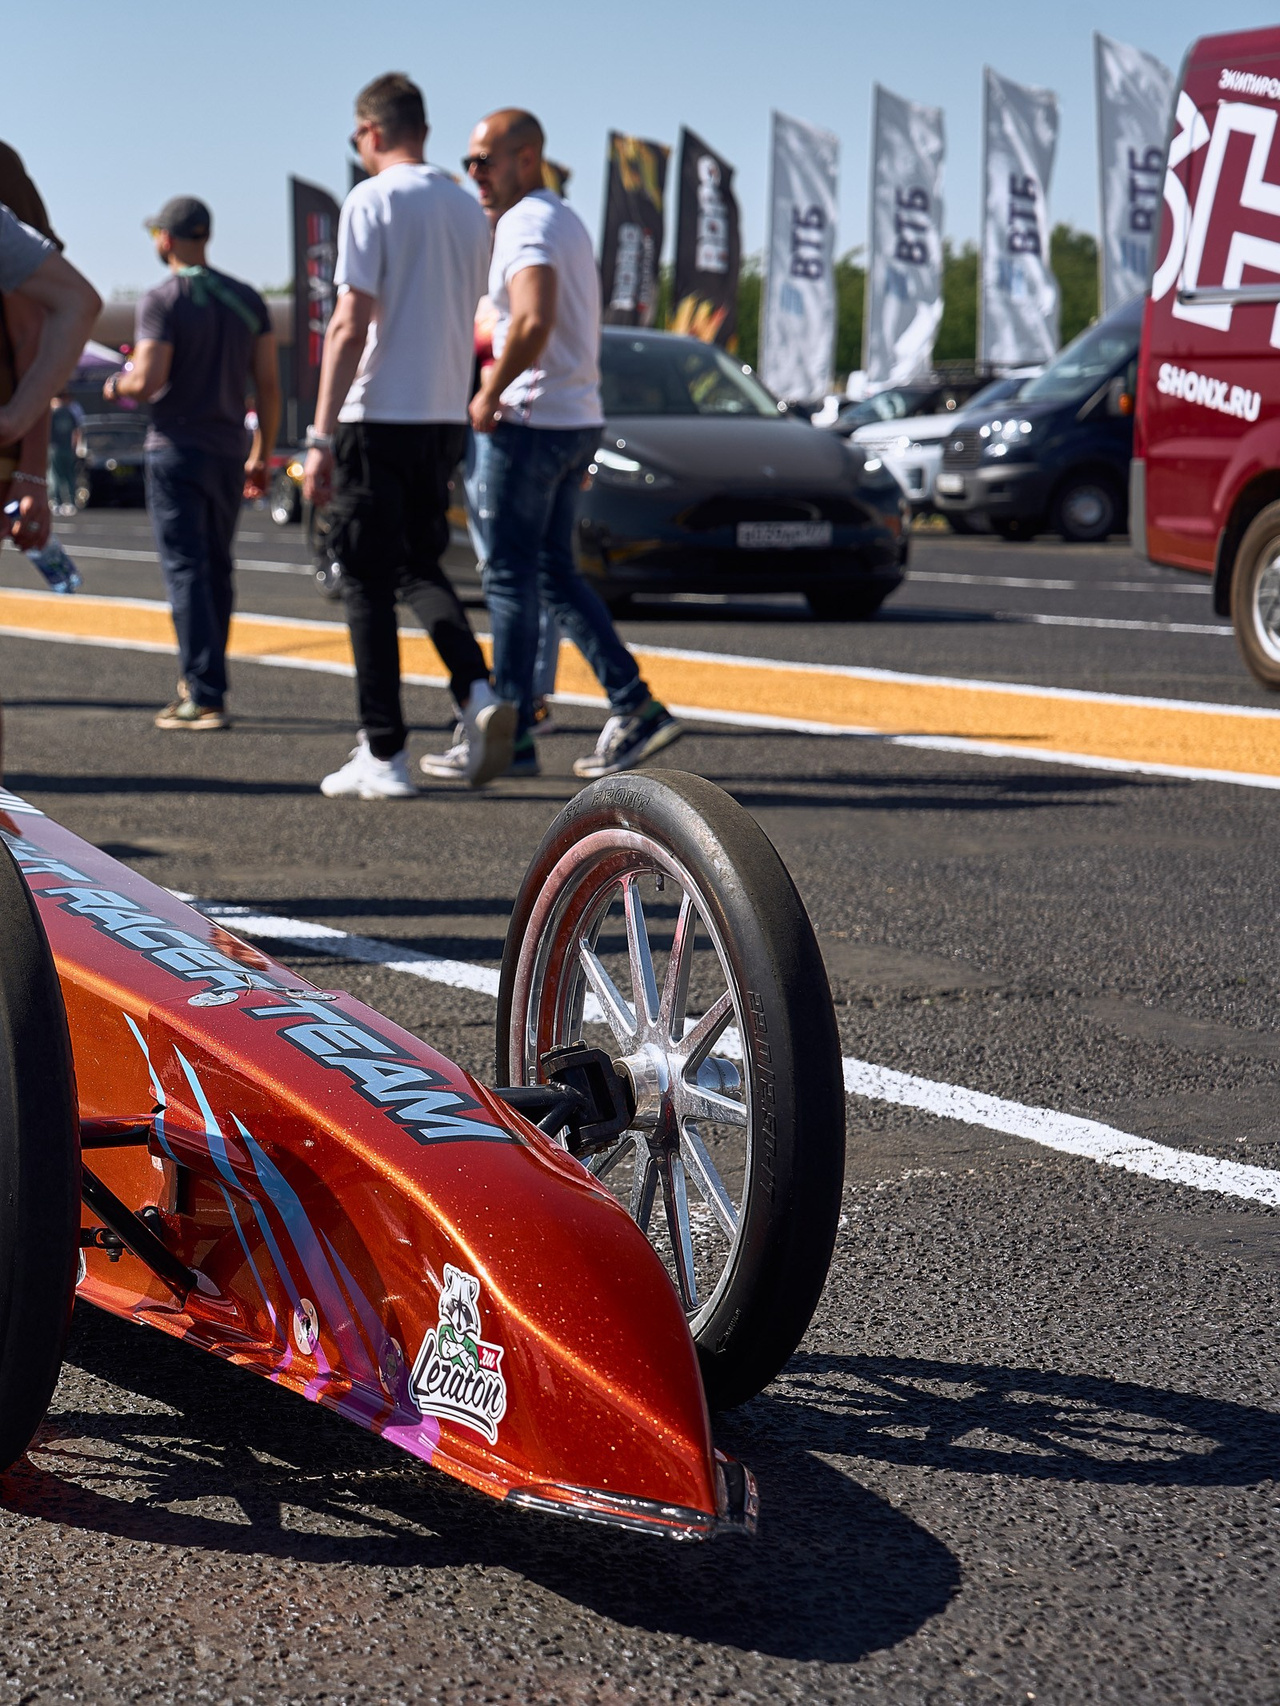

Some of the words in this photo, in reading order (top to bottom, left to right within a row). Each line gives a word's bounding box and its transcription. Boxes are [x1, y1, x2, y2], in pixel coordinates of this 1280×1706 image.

[1218, 67, 1280, 100] ЭКИПИРО
[791, 201, 828, 281] ВТБ
[894, 184, 933, 267] ВТБ
[1007, 171, 1043, 256] ВТБ
[1156, 362, 1262, 422] SHONX.RU
[591, 787, 652, 812] FRONT
[38, 886, 292, 995] RACER
[244, 997, 520, 1143] TEAM
[412, 1338, 502, 1414] Leraton
